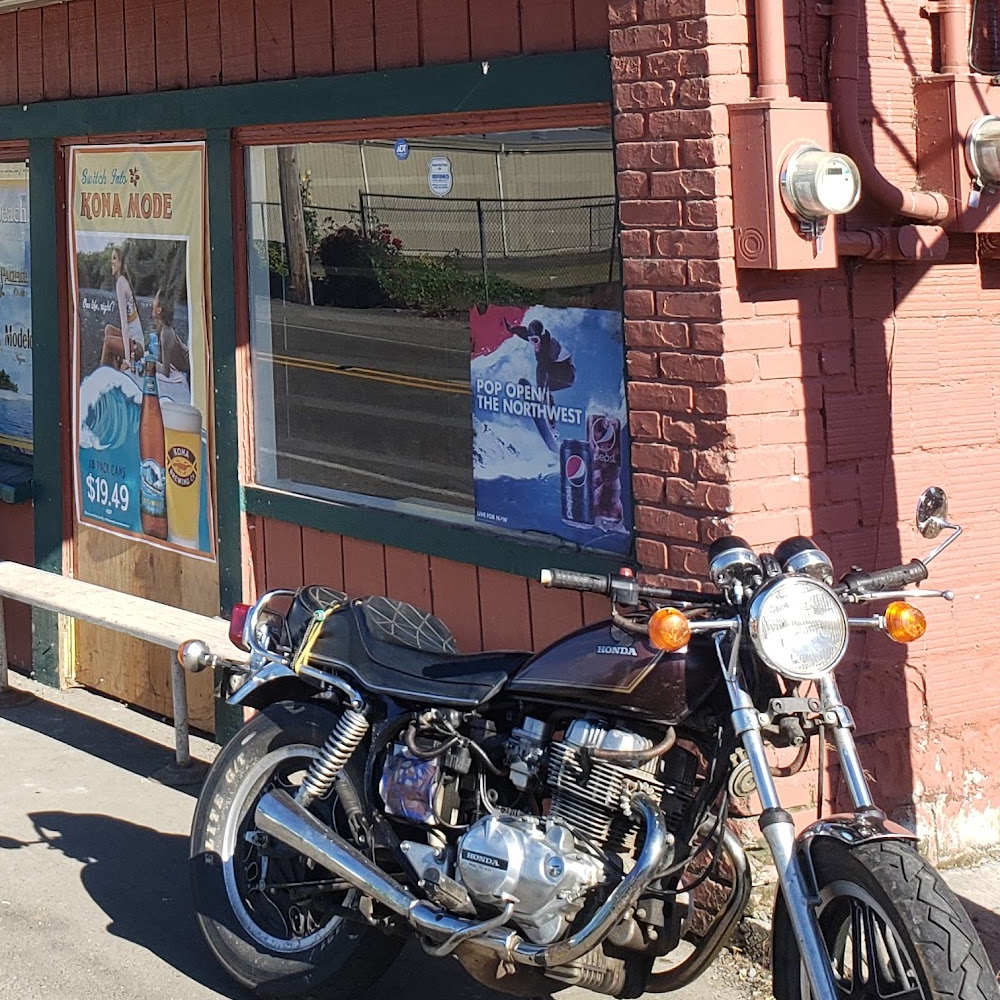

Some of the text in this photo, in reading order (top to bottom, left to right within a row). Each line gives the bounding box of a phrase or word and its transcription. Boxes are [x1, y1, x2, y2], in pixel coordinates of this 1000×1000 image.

[81, 168, 127, 185] Switch Into
[80, 192, 173, 220] KONA MODE
[476, 379, 544, 401] POP OPEN
[477, 395, 582, 425] THE NORTHWEST
[173, 447, 190, 459] KONA
[86, 473, 129, 511] $19.49
[566, 486, 574, 519] pepsi
[597, 645, 638, 656] HONDA
[466, 852, 500, 867] HONDA
